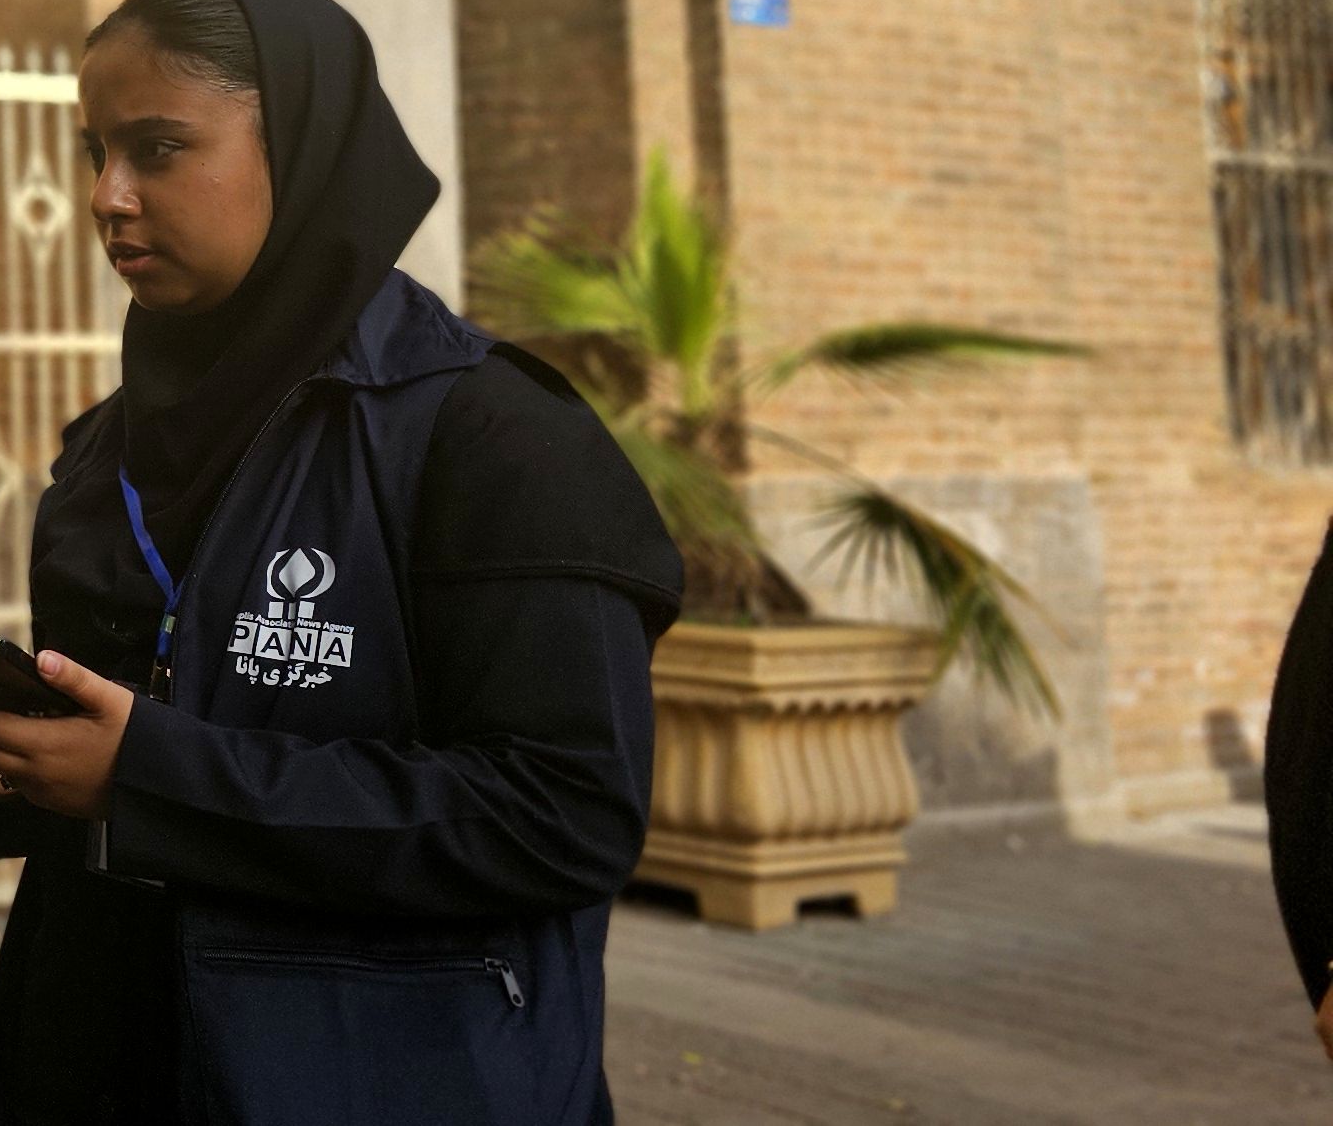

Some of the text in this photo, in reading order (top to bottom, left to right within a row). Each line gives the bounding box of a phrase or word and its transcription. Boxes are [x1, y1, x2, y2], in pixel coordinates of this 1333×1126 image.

[297, 618, 321, 628] News
[323, 621, 354, 634] Agency
[229, 624, 346, 662] PANA
[235, 655, 259, 684] پانا
